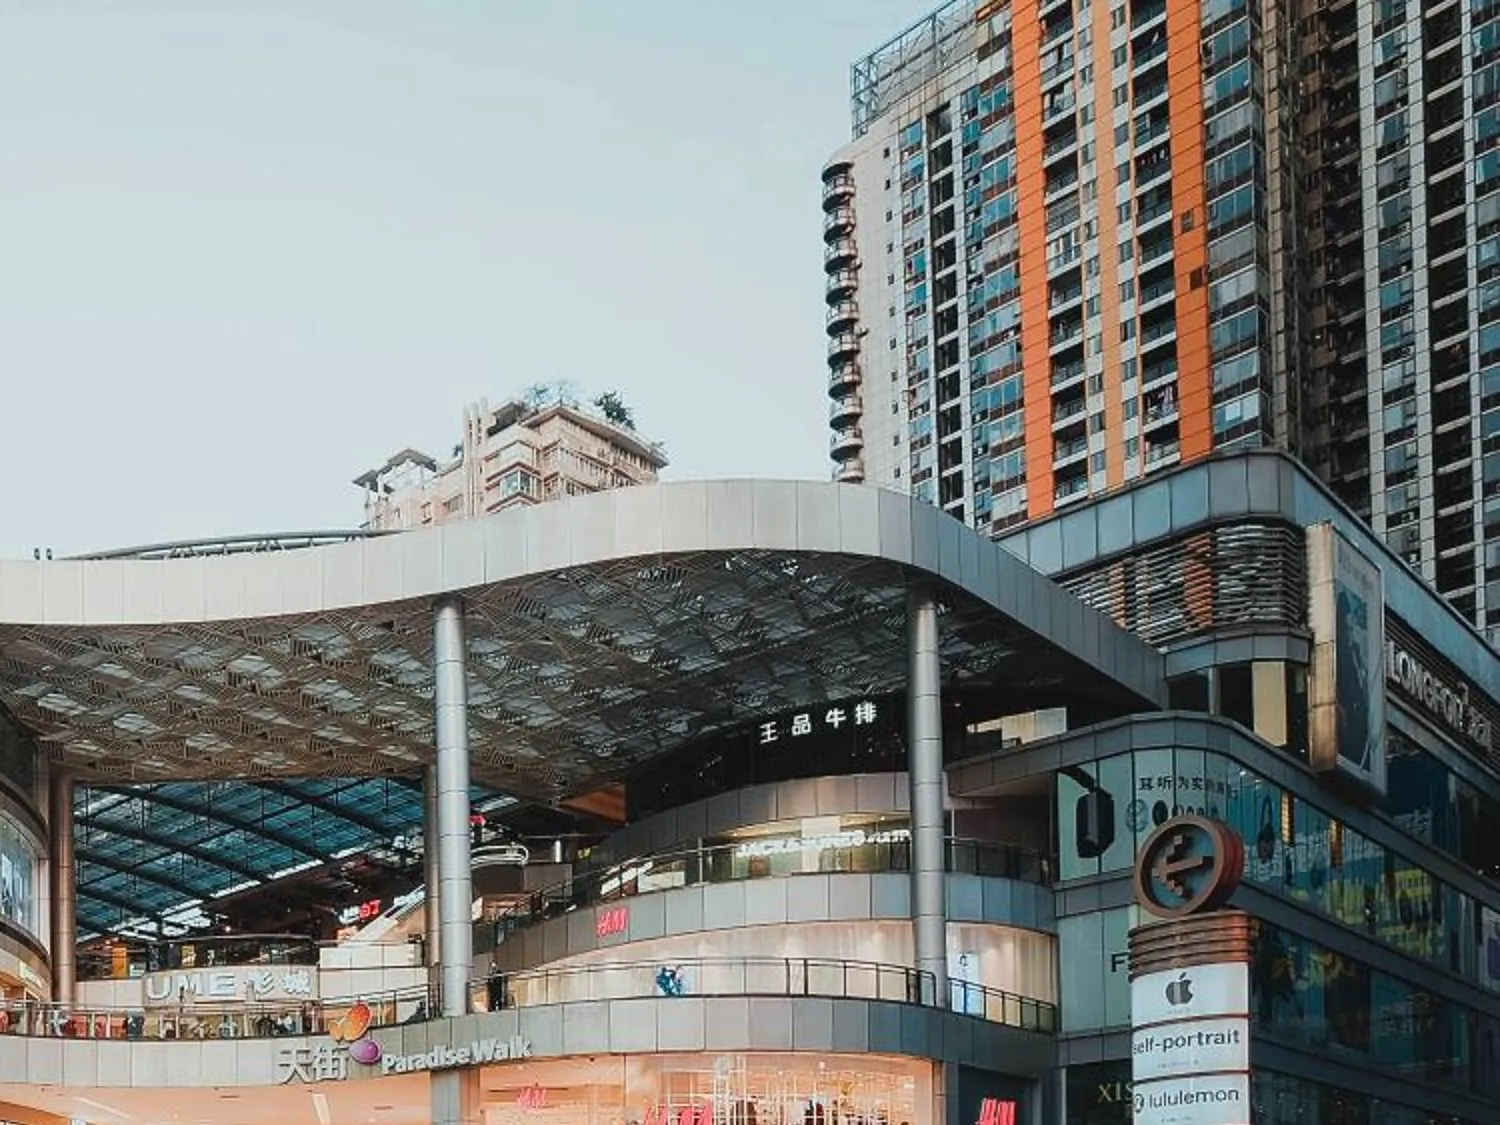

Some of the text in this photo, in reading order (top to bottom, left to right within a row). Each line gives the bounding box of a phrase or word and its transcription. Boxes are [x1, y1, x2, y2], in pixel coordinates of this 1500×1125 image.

[759, 700, 877, 744] 王品牛排
[597, 908, 627, 937] H&M
[146, 970, 236, 1000] UME
[1132, 1028, 1240, 1055] self-portrait
[275, 1043, 349, 1085] 天街
[1149, 1088, 1239, 1109] lululemon
